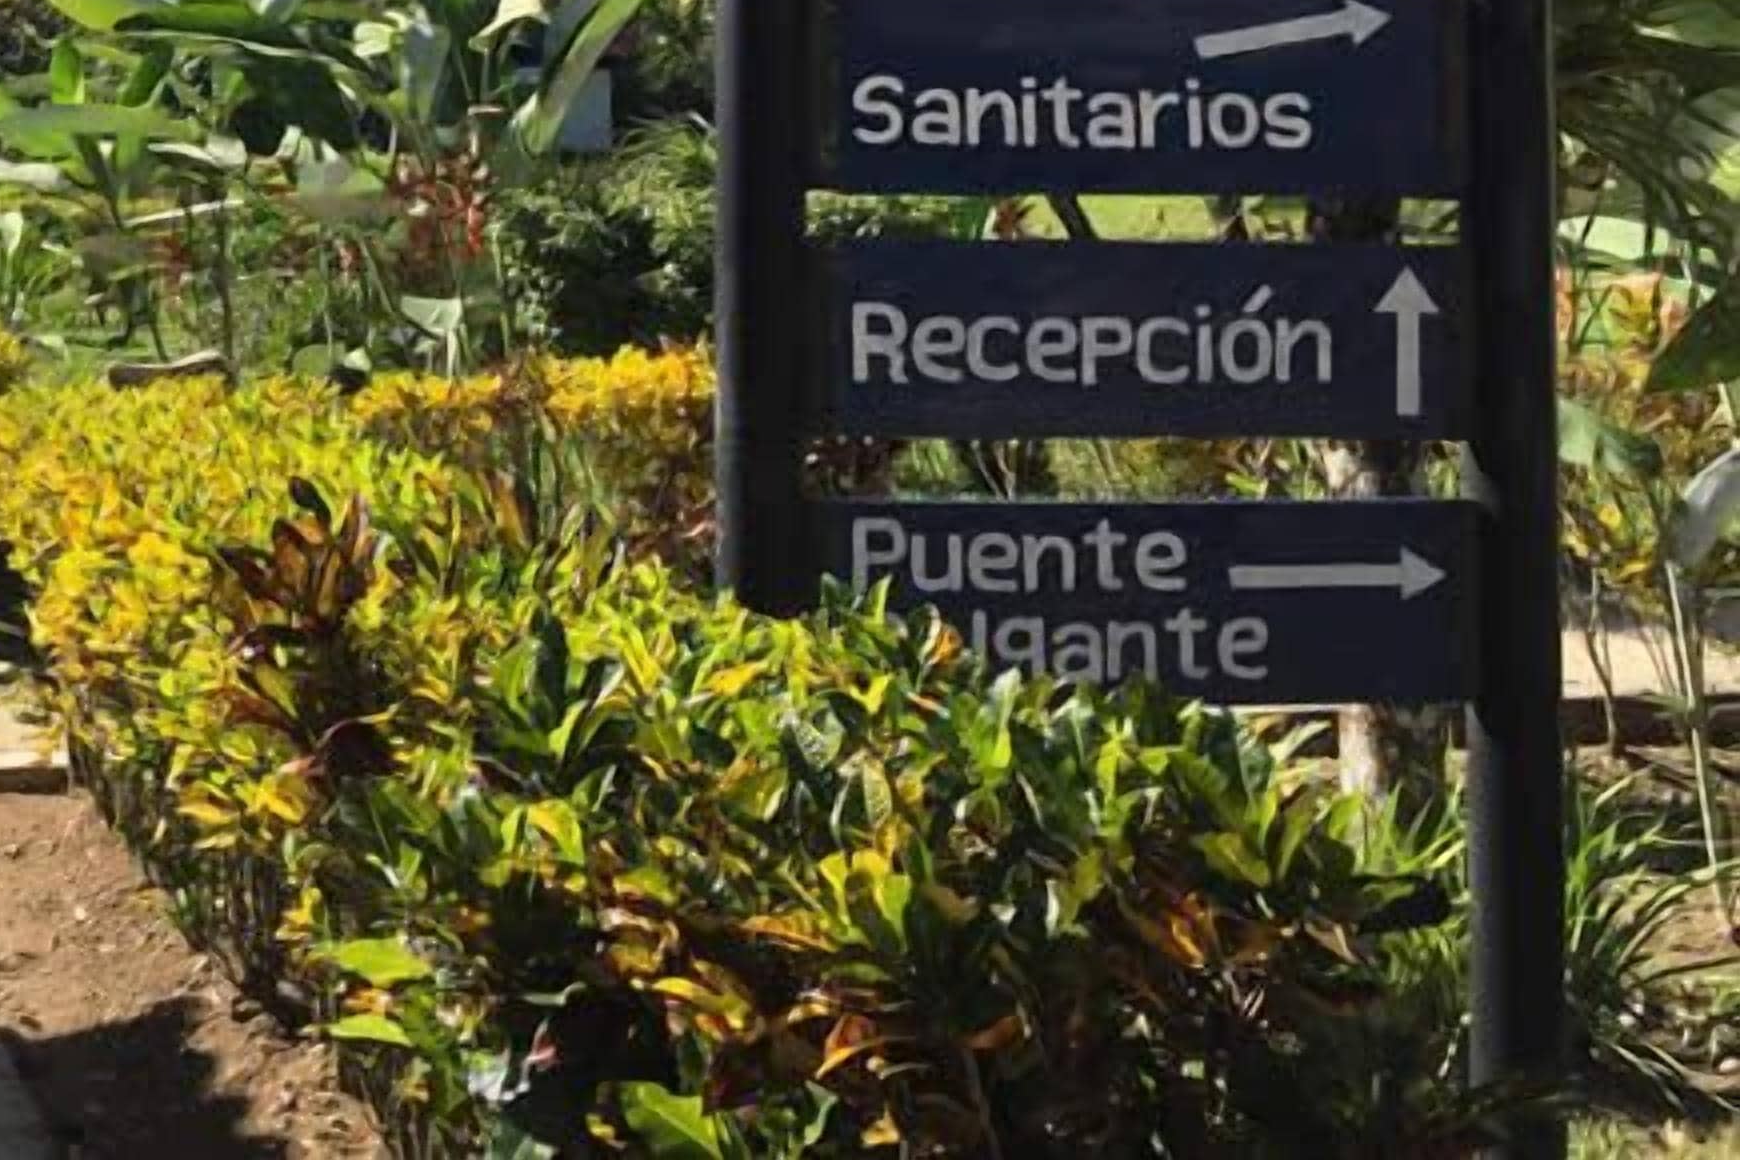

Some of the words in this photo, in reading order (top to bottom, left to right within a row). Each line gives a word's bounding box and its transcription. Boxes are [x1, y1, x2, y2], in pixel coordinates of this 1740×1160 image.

[851, 75, 1313, 149] Sanitarios
[850, 285, 1333, 387] Recepción
[851, 516, 1187, 594] Puente
[888, 607, 1269, 682] lgante
